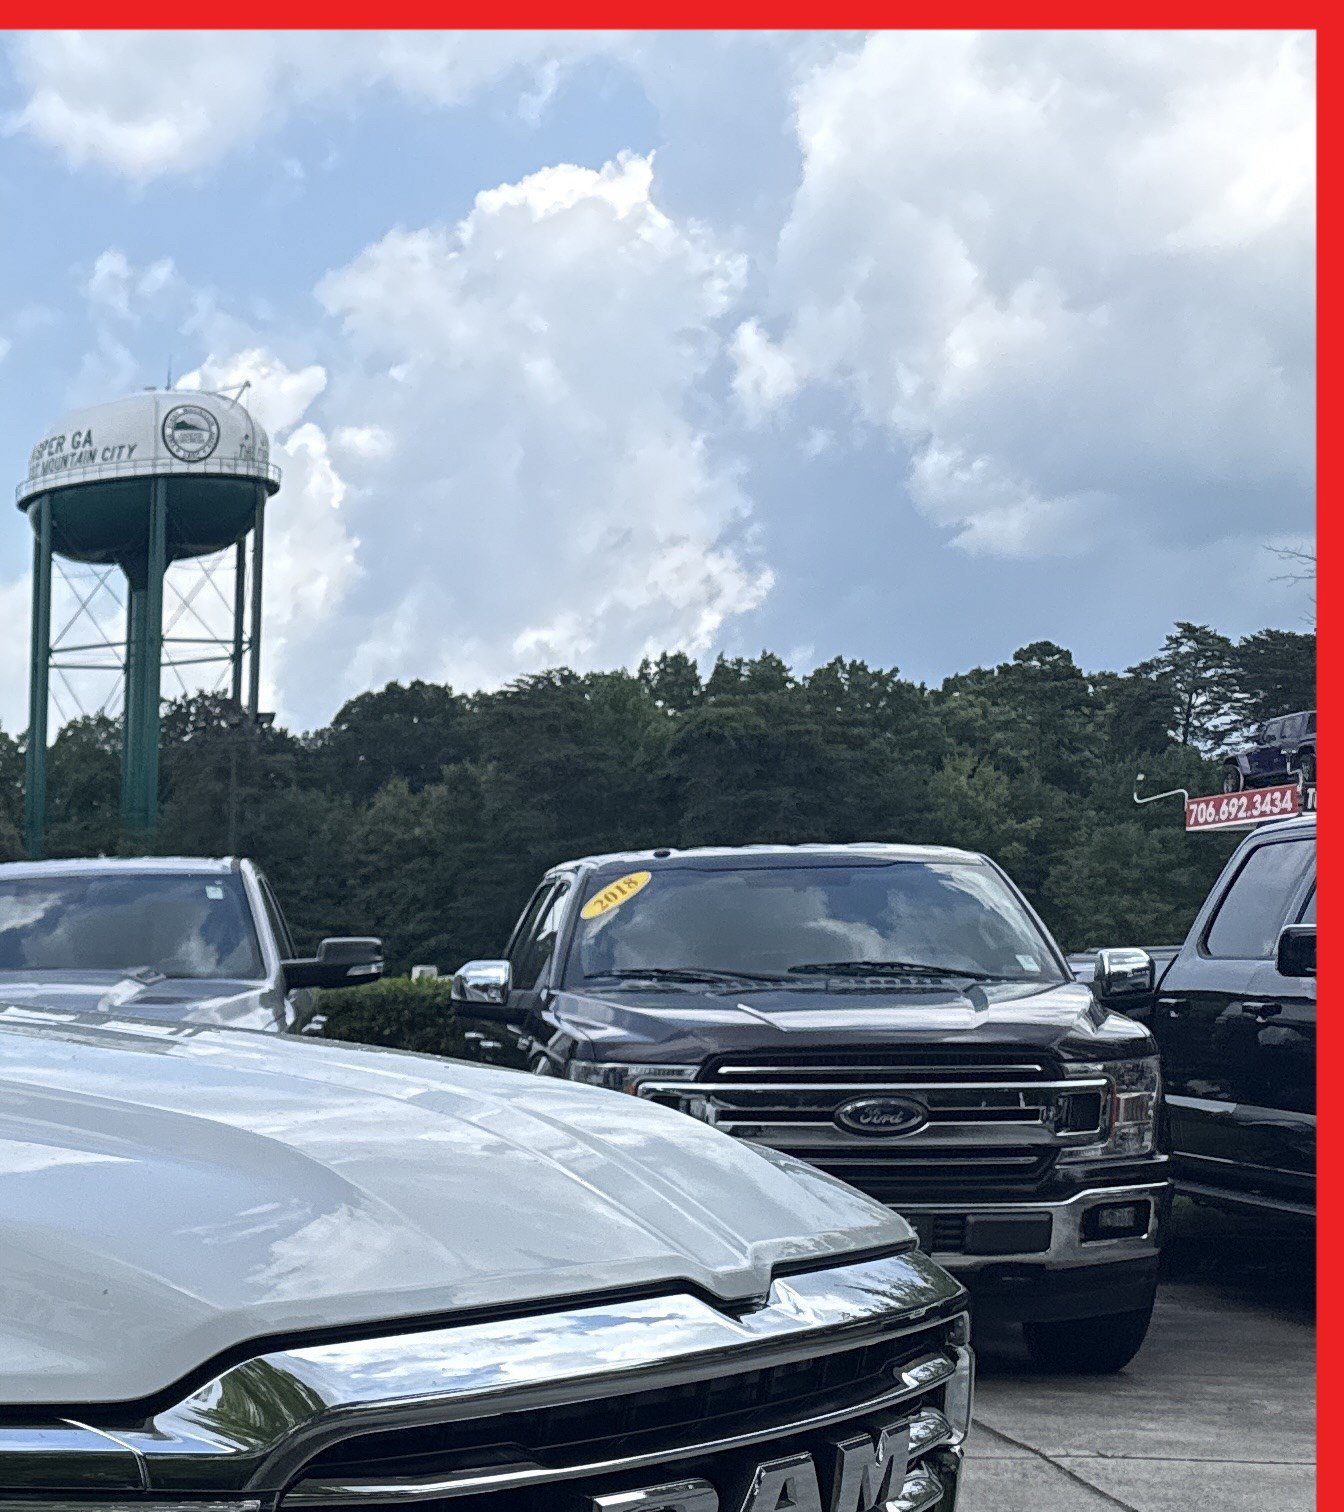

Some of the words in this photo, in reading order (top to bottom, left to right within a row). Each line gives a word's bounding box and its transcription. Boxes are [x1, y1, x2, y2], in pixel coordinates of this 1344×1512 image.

[71, 429, 92, 450] GA
[101, 443, 137, 462] CITY
[1189, 790, 1293, 825] 706.692.3434
[593, 878, 639, 911] 2018
[859, 1107, 905, 1125] Ford
